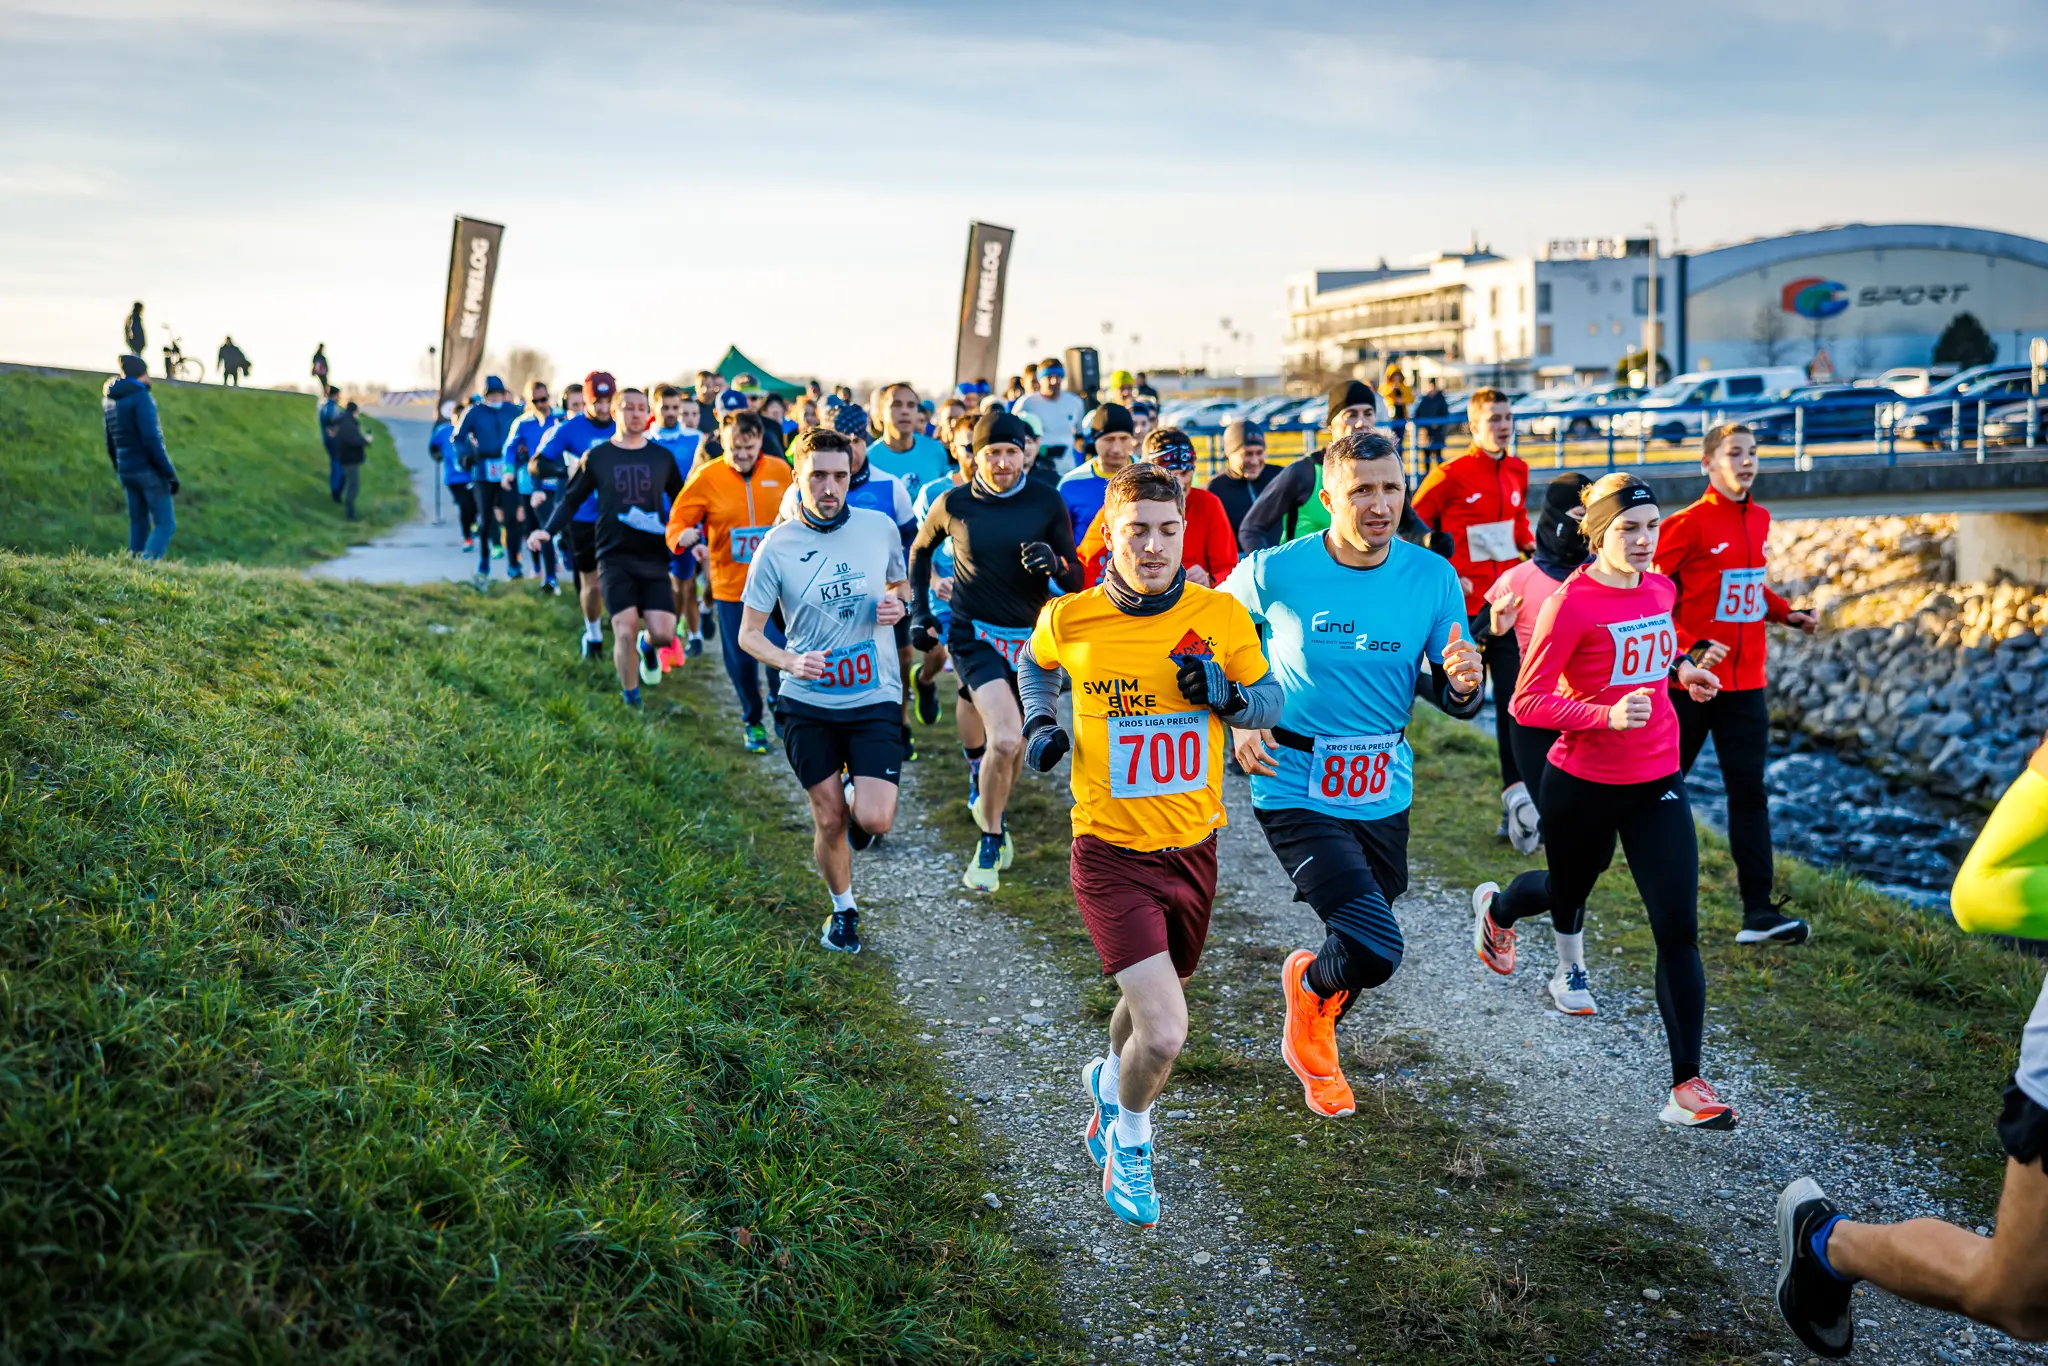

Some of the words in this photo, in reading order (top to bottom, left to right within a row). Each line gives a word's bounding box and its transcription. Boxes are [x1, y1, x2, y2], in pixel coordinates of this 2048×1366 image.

[1857, 283, 1971, 307] SPORT
[836, 562, 851, 573] 10.
[820, 582, 852, 601] K15
[1311, 610, 1355, 634] Fund
[1618, 625, 1635, 633] KROS
[1355, 633, 1402, 652] Race
[1622, 629, 1673, 677] 679
[819, 653, 873, 689] 509
[1083, 678, 1139, 694] SWIM
[1108, 694, 1157, 709] BIKE
[1119, 720, 1143, 728] KROS
[1145, 718, 1165, 727] LIGA
[1167, 716, 1199, 726] PRELOG
[1326, 744, 1348, 752] KROS
[1349, 744, 1367, 752] LIGA
[1368, 741, 1394, 751] PRELOG
[1118, 730, 1201, 785] 700
[1321, 751, 1391, 798] 888
